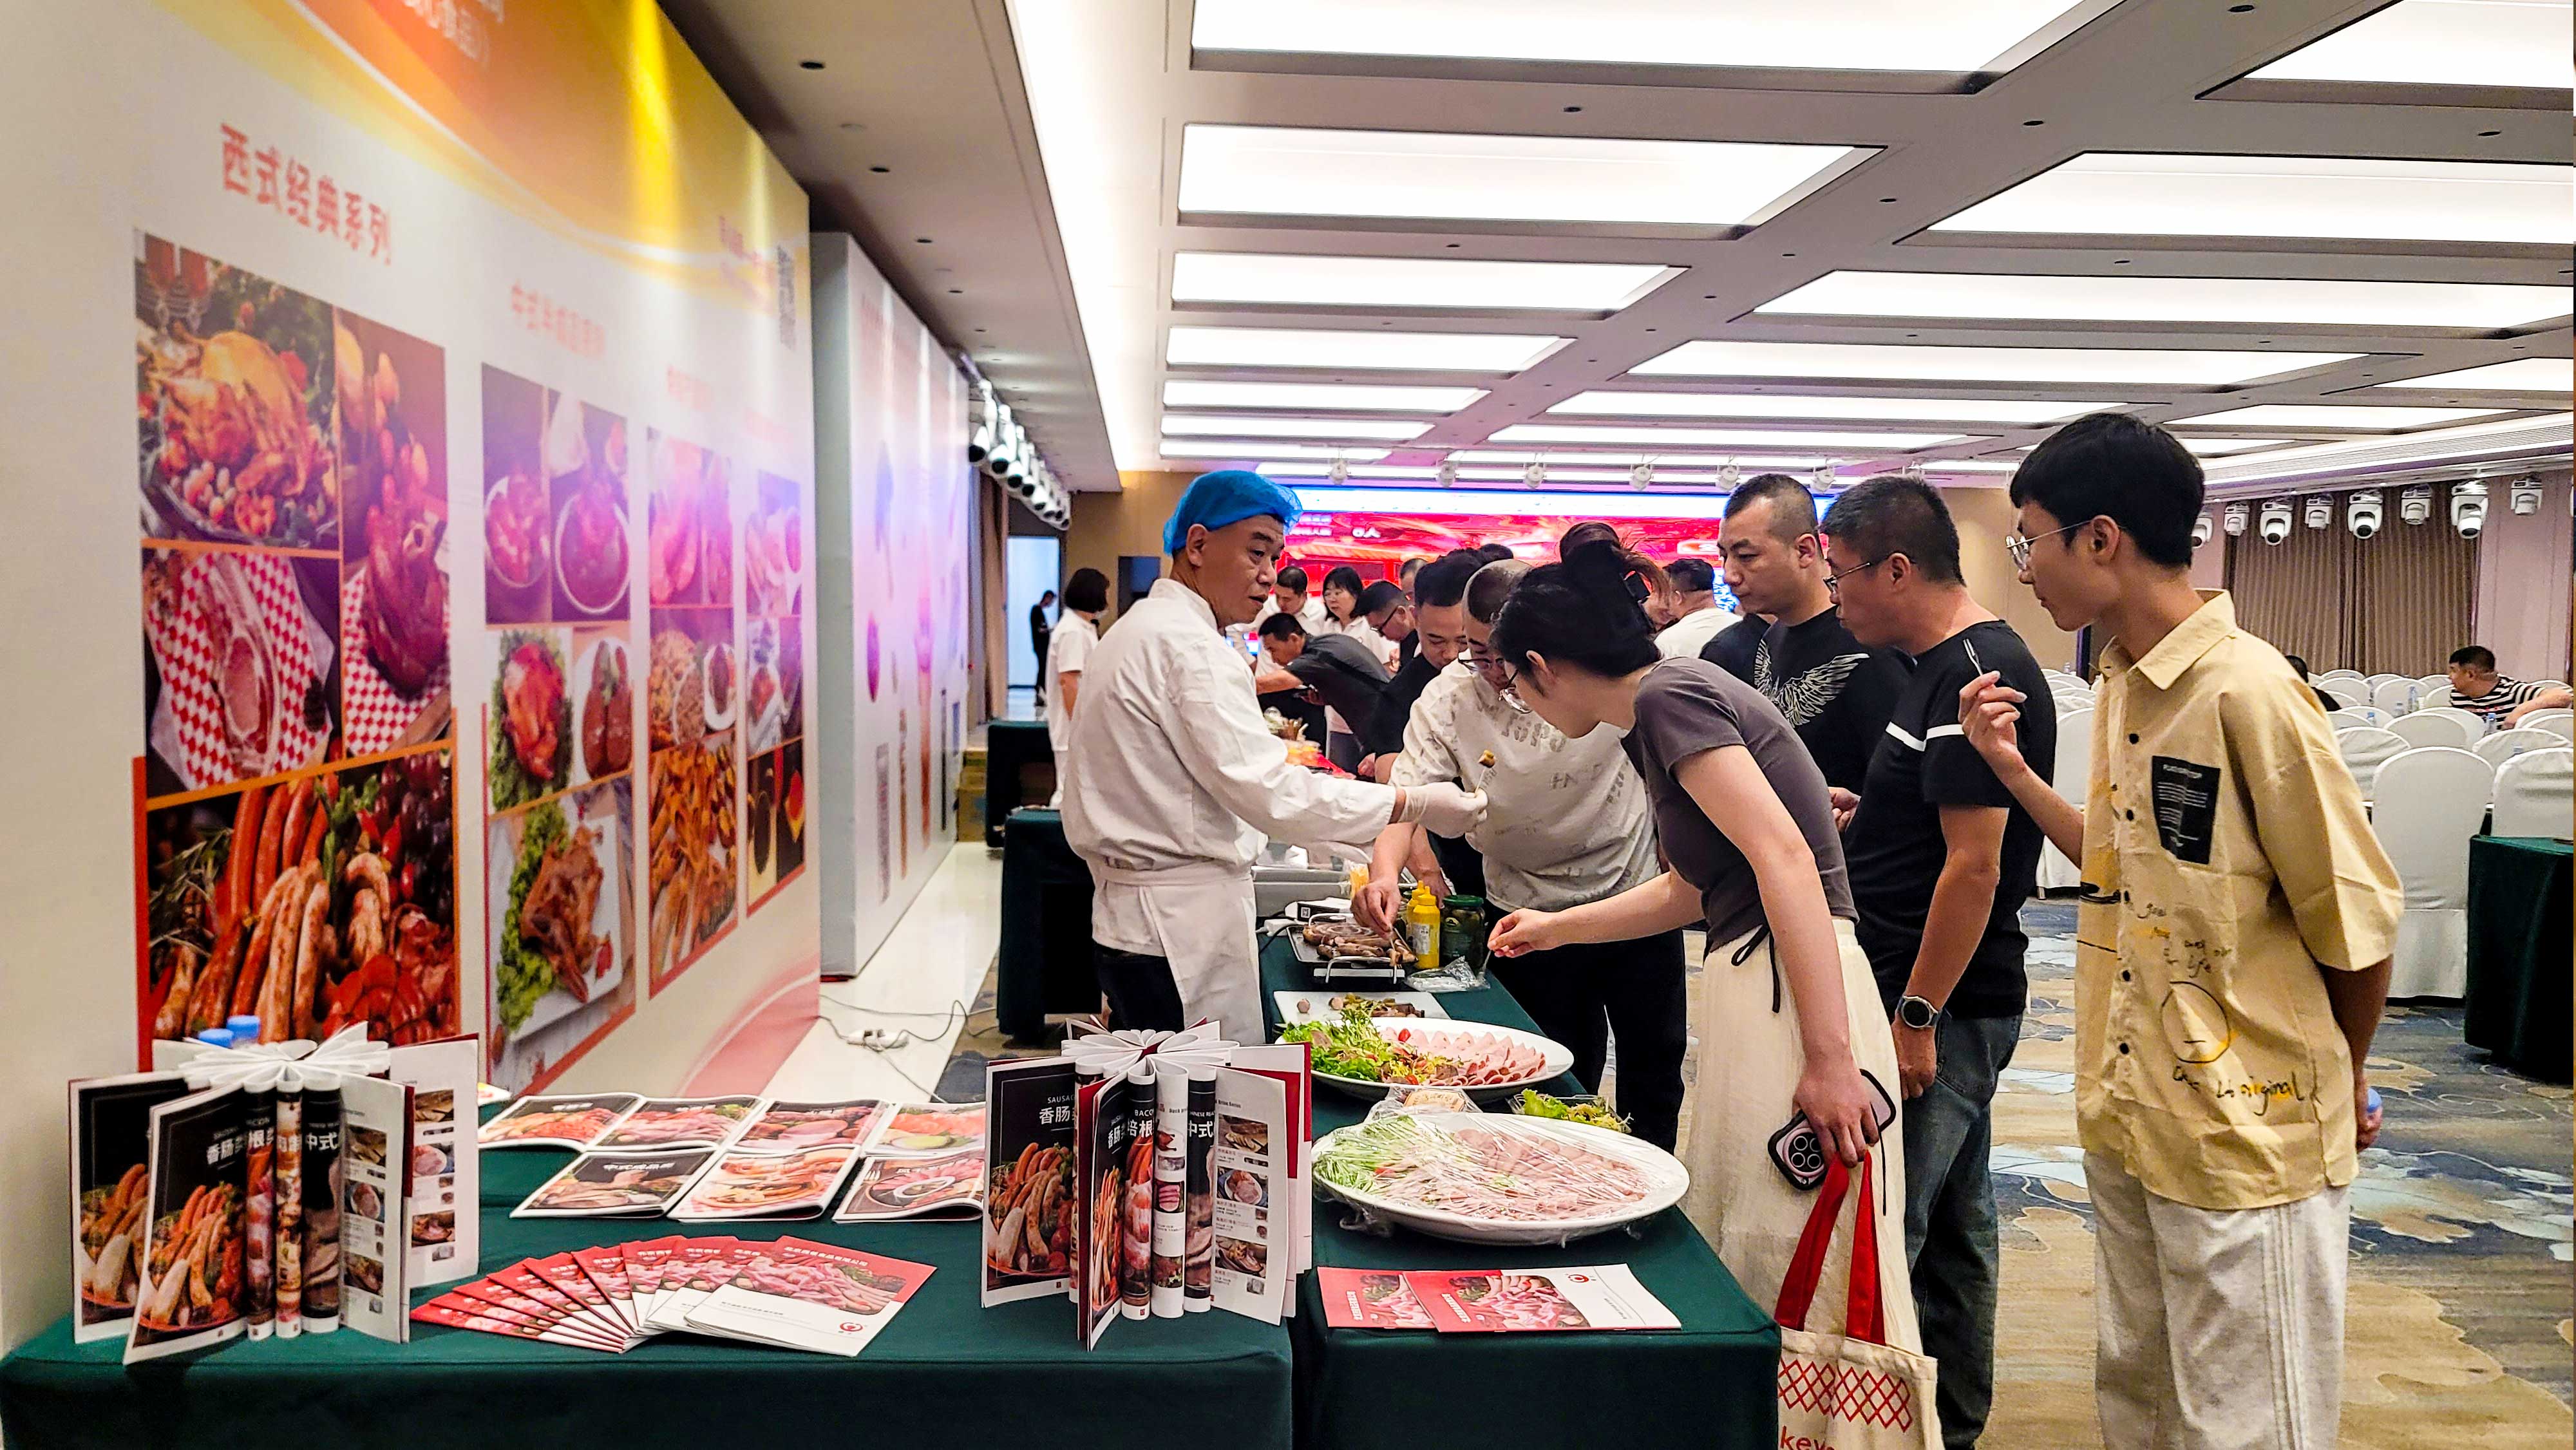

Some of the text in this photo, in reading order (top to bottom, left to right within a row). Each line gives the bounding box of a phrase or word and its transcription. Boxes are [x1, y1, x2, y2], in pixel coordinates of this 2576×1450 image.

[221, 123, 390, 265] 西式经典系列
[1188, 1120, 1213, 1138] 中式
[305, 1132, 338, 1151] 中式
